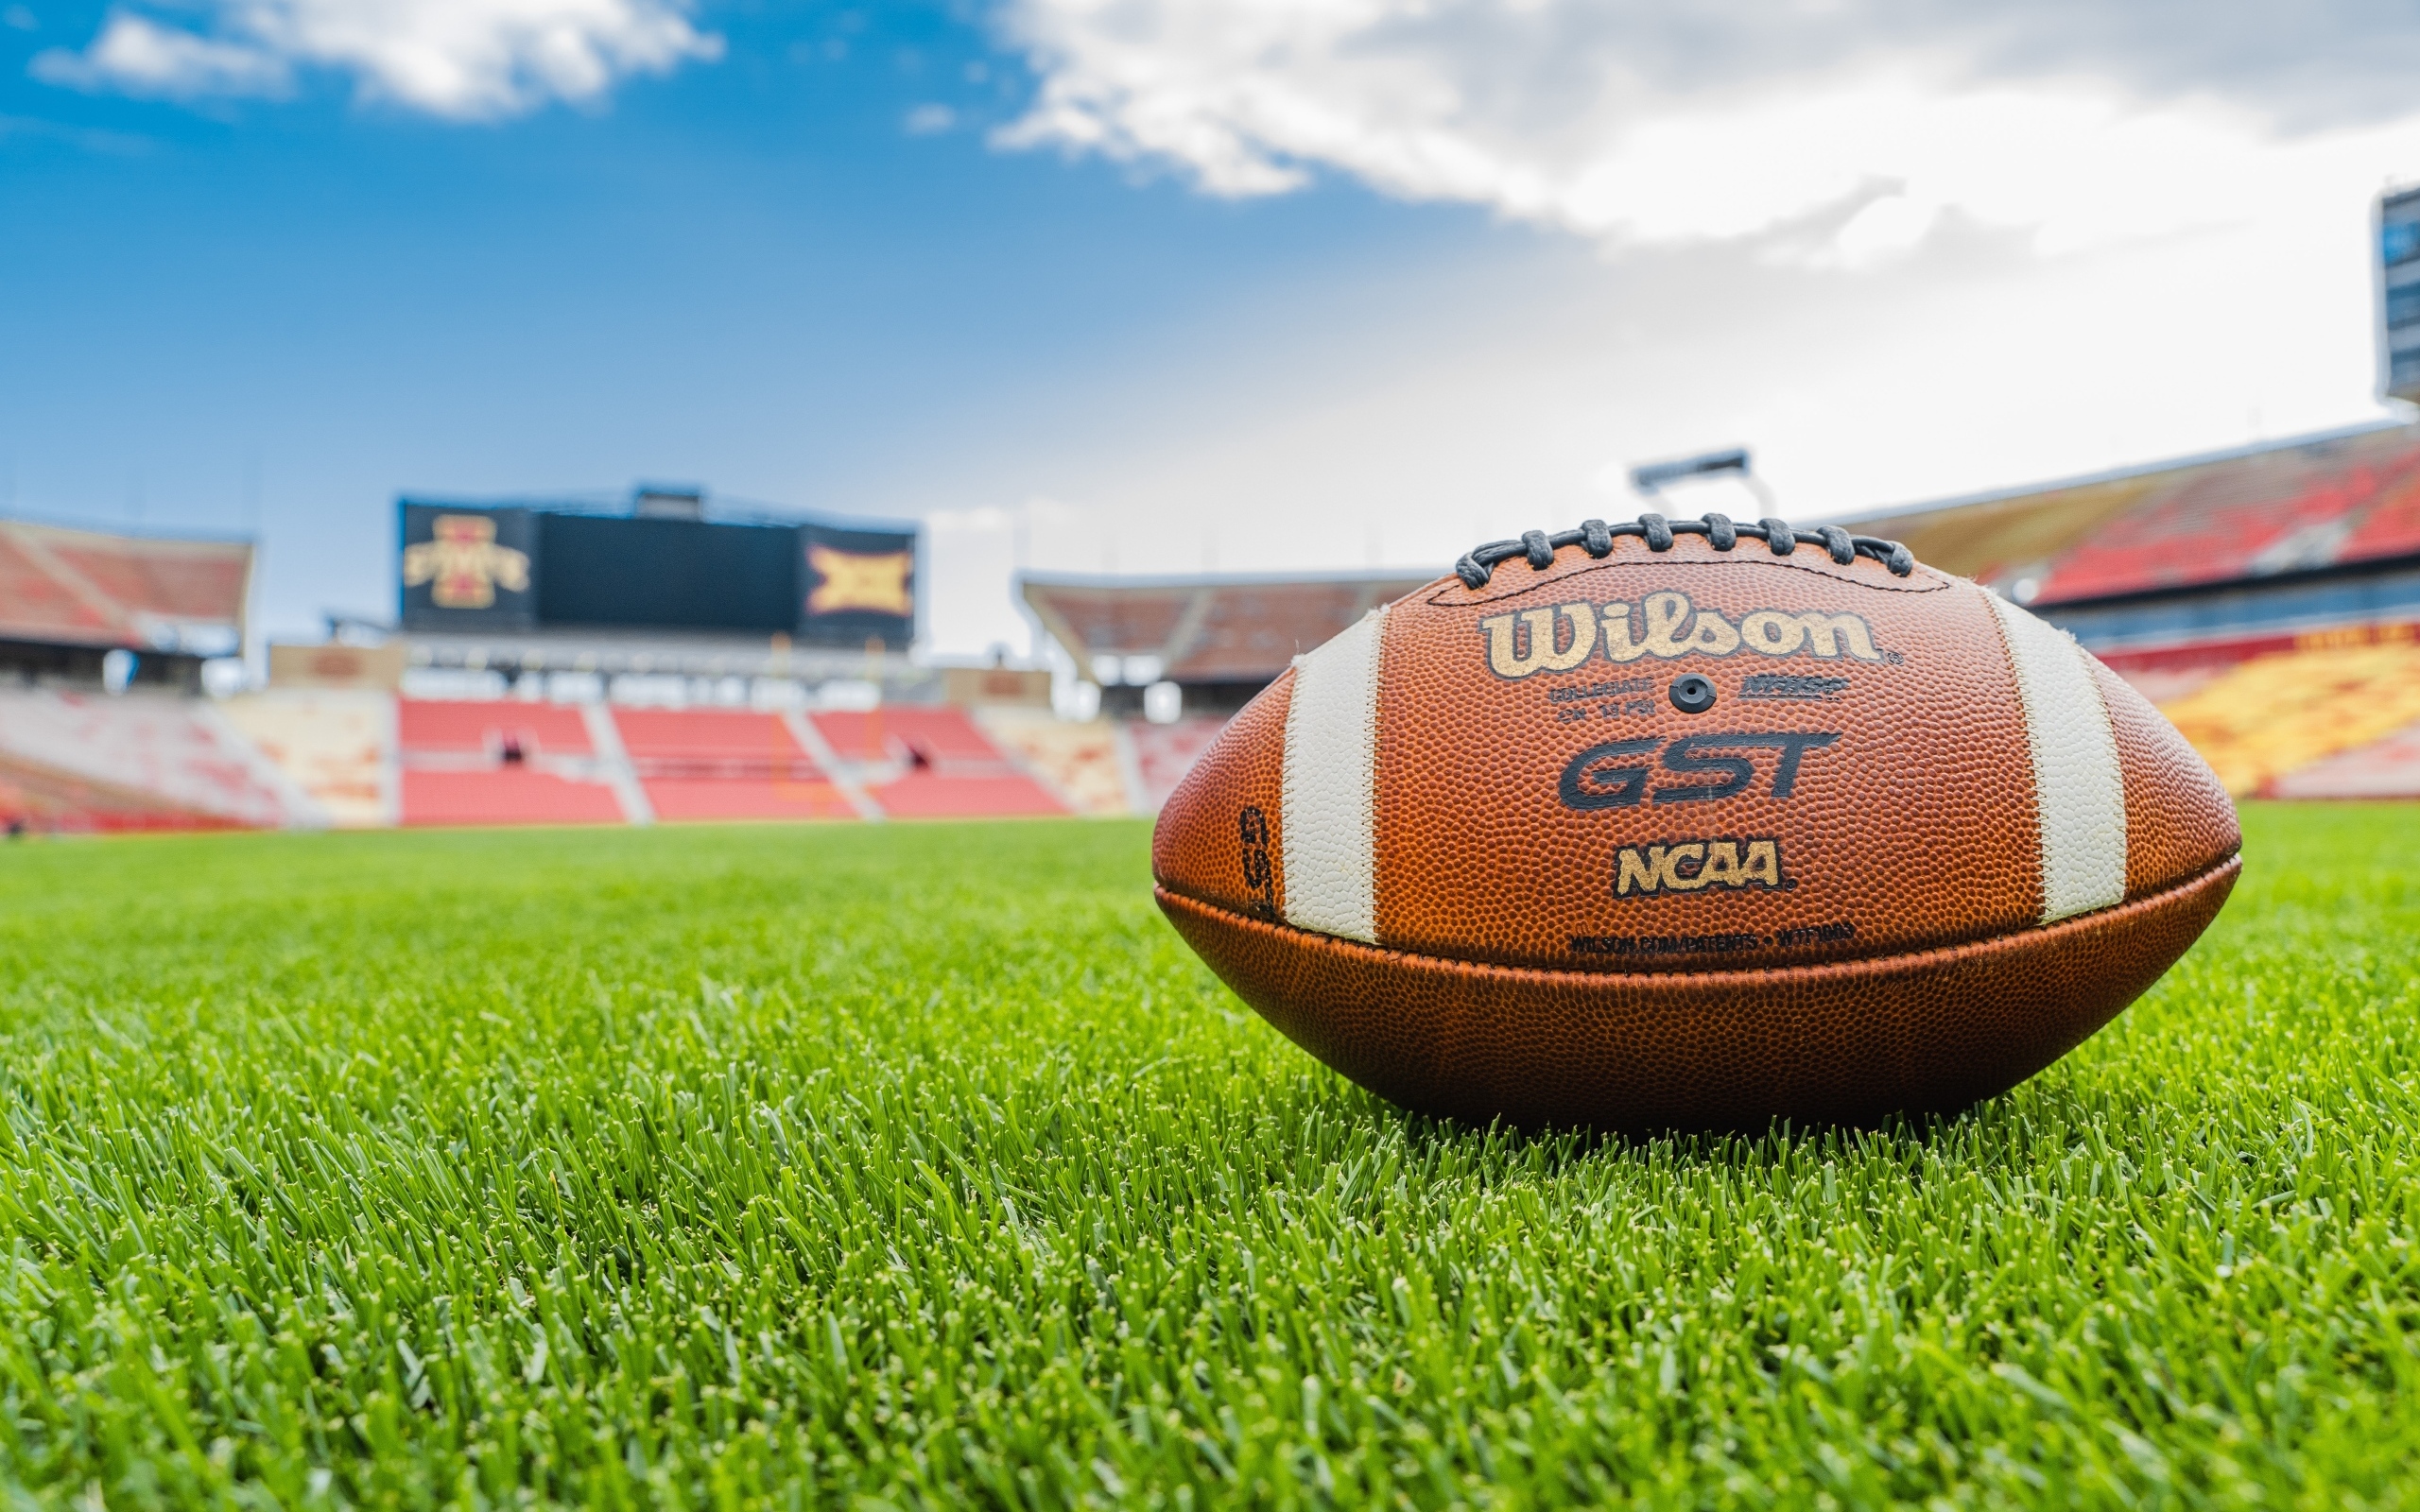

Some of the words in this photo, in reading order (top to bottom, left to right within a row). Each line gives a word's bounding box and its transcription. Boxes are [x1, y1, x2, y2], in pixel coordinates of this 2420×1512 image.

[1478, 590, 1885, 680] Wilson
[1549, 675, 1654, 703] COLLEGIATE
[1559, 731, 1839, 810] GST
[1612, 836, 1784, 899] NCAA
